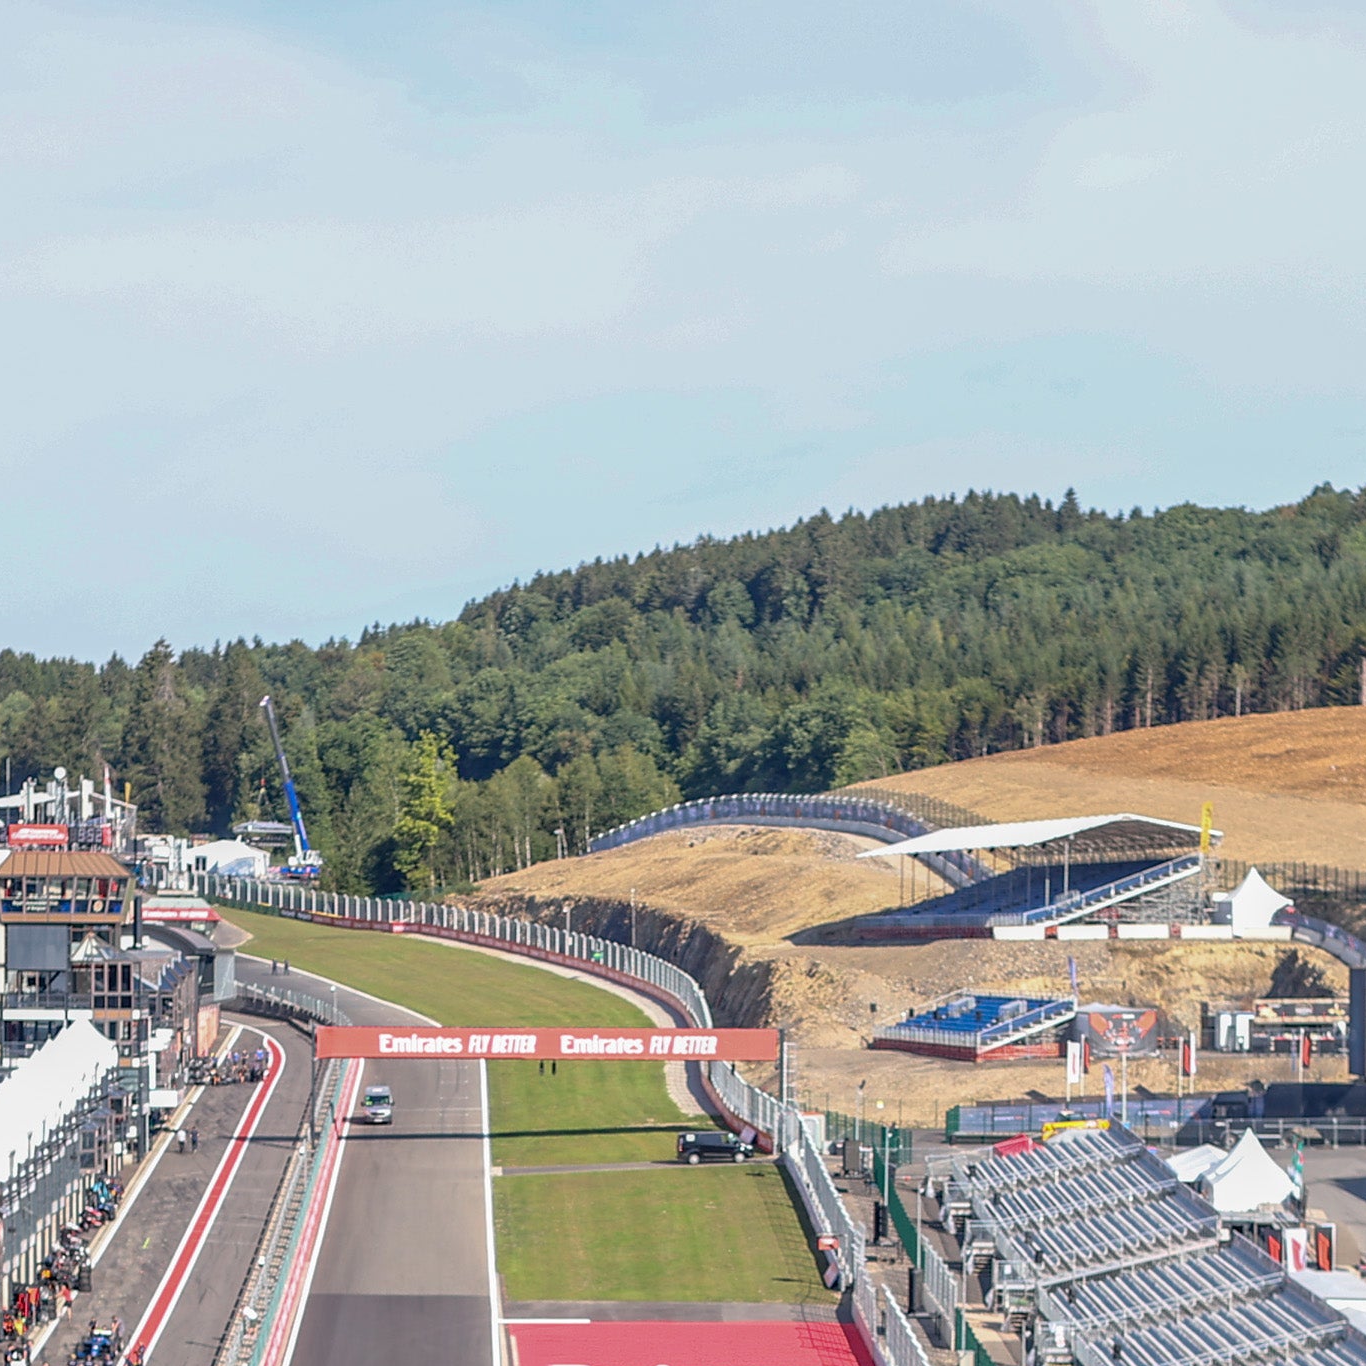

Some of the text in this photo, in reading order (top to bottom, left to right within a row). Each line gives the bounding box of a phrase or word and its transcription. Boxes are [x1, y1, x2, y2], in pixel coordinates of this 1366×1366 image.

[379, 1033, 537, 1054] Emirates FLY BETTER
[560, 1034, 717, 1055] Emirates FLY BETTER
